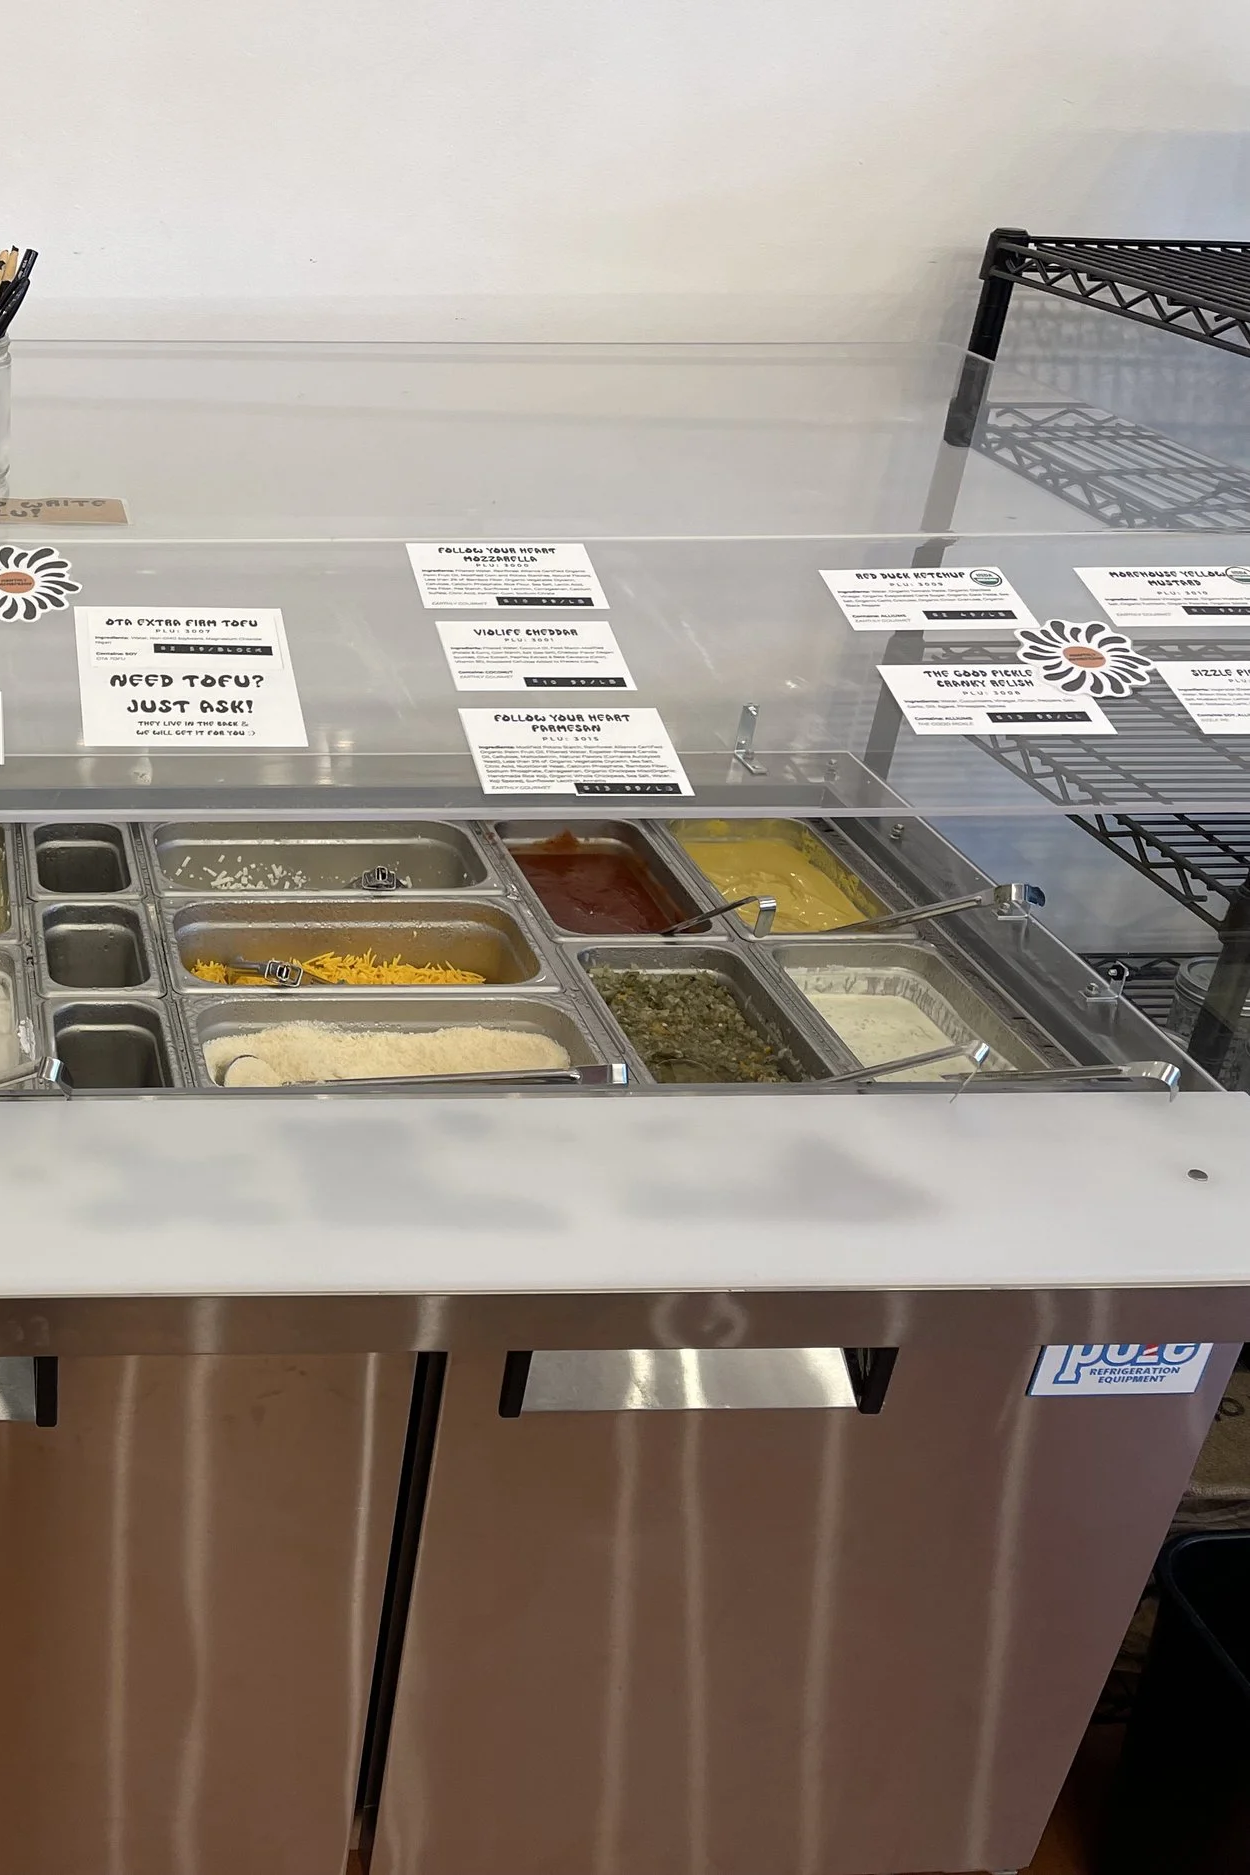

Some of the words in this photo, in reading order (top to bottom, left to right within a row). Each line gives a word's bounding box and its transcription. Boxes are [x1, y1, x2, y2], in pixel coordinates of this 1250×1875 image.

[105, 618, 132, 626] OTA
[137, 619, 181, 627] EXTRA
[110, 674, 174, 687] NEED
[182, 675, 264, 688] TOFU?
[937, 680, 987, 688] CRANKY
[127, 700, 190, 713] JUST
[200, 700, 253, 714] ASK!
[494, 714, 546, 722] FOLLOW
[549, 714, 584, 722] YOUR
[532, 724, 601, 733] PARMESAN
[1090, 1367, 1180, 1375] REFRIGERATION
